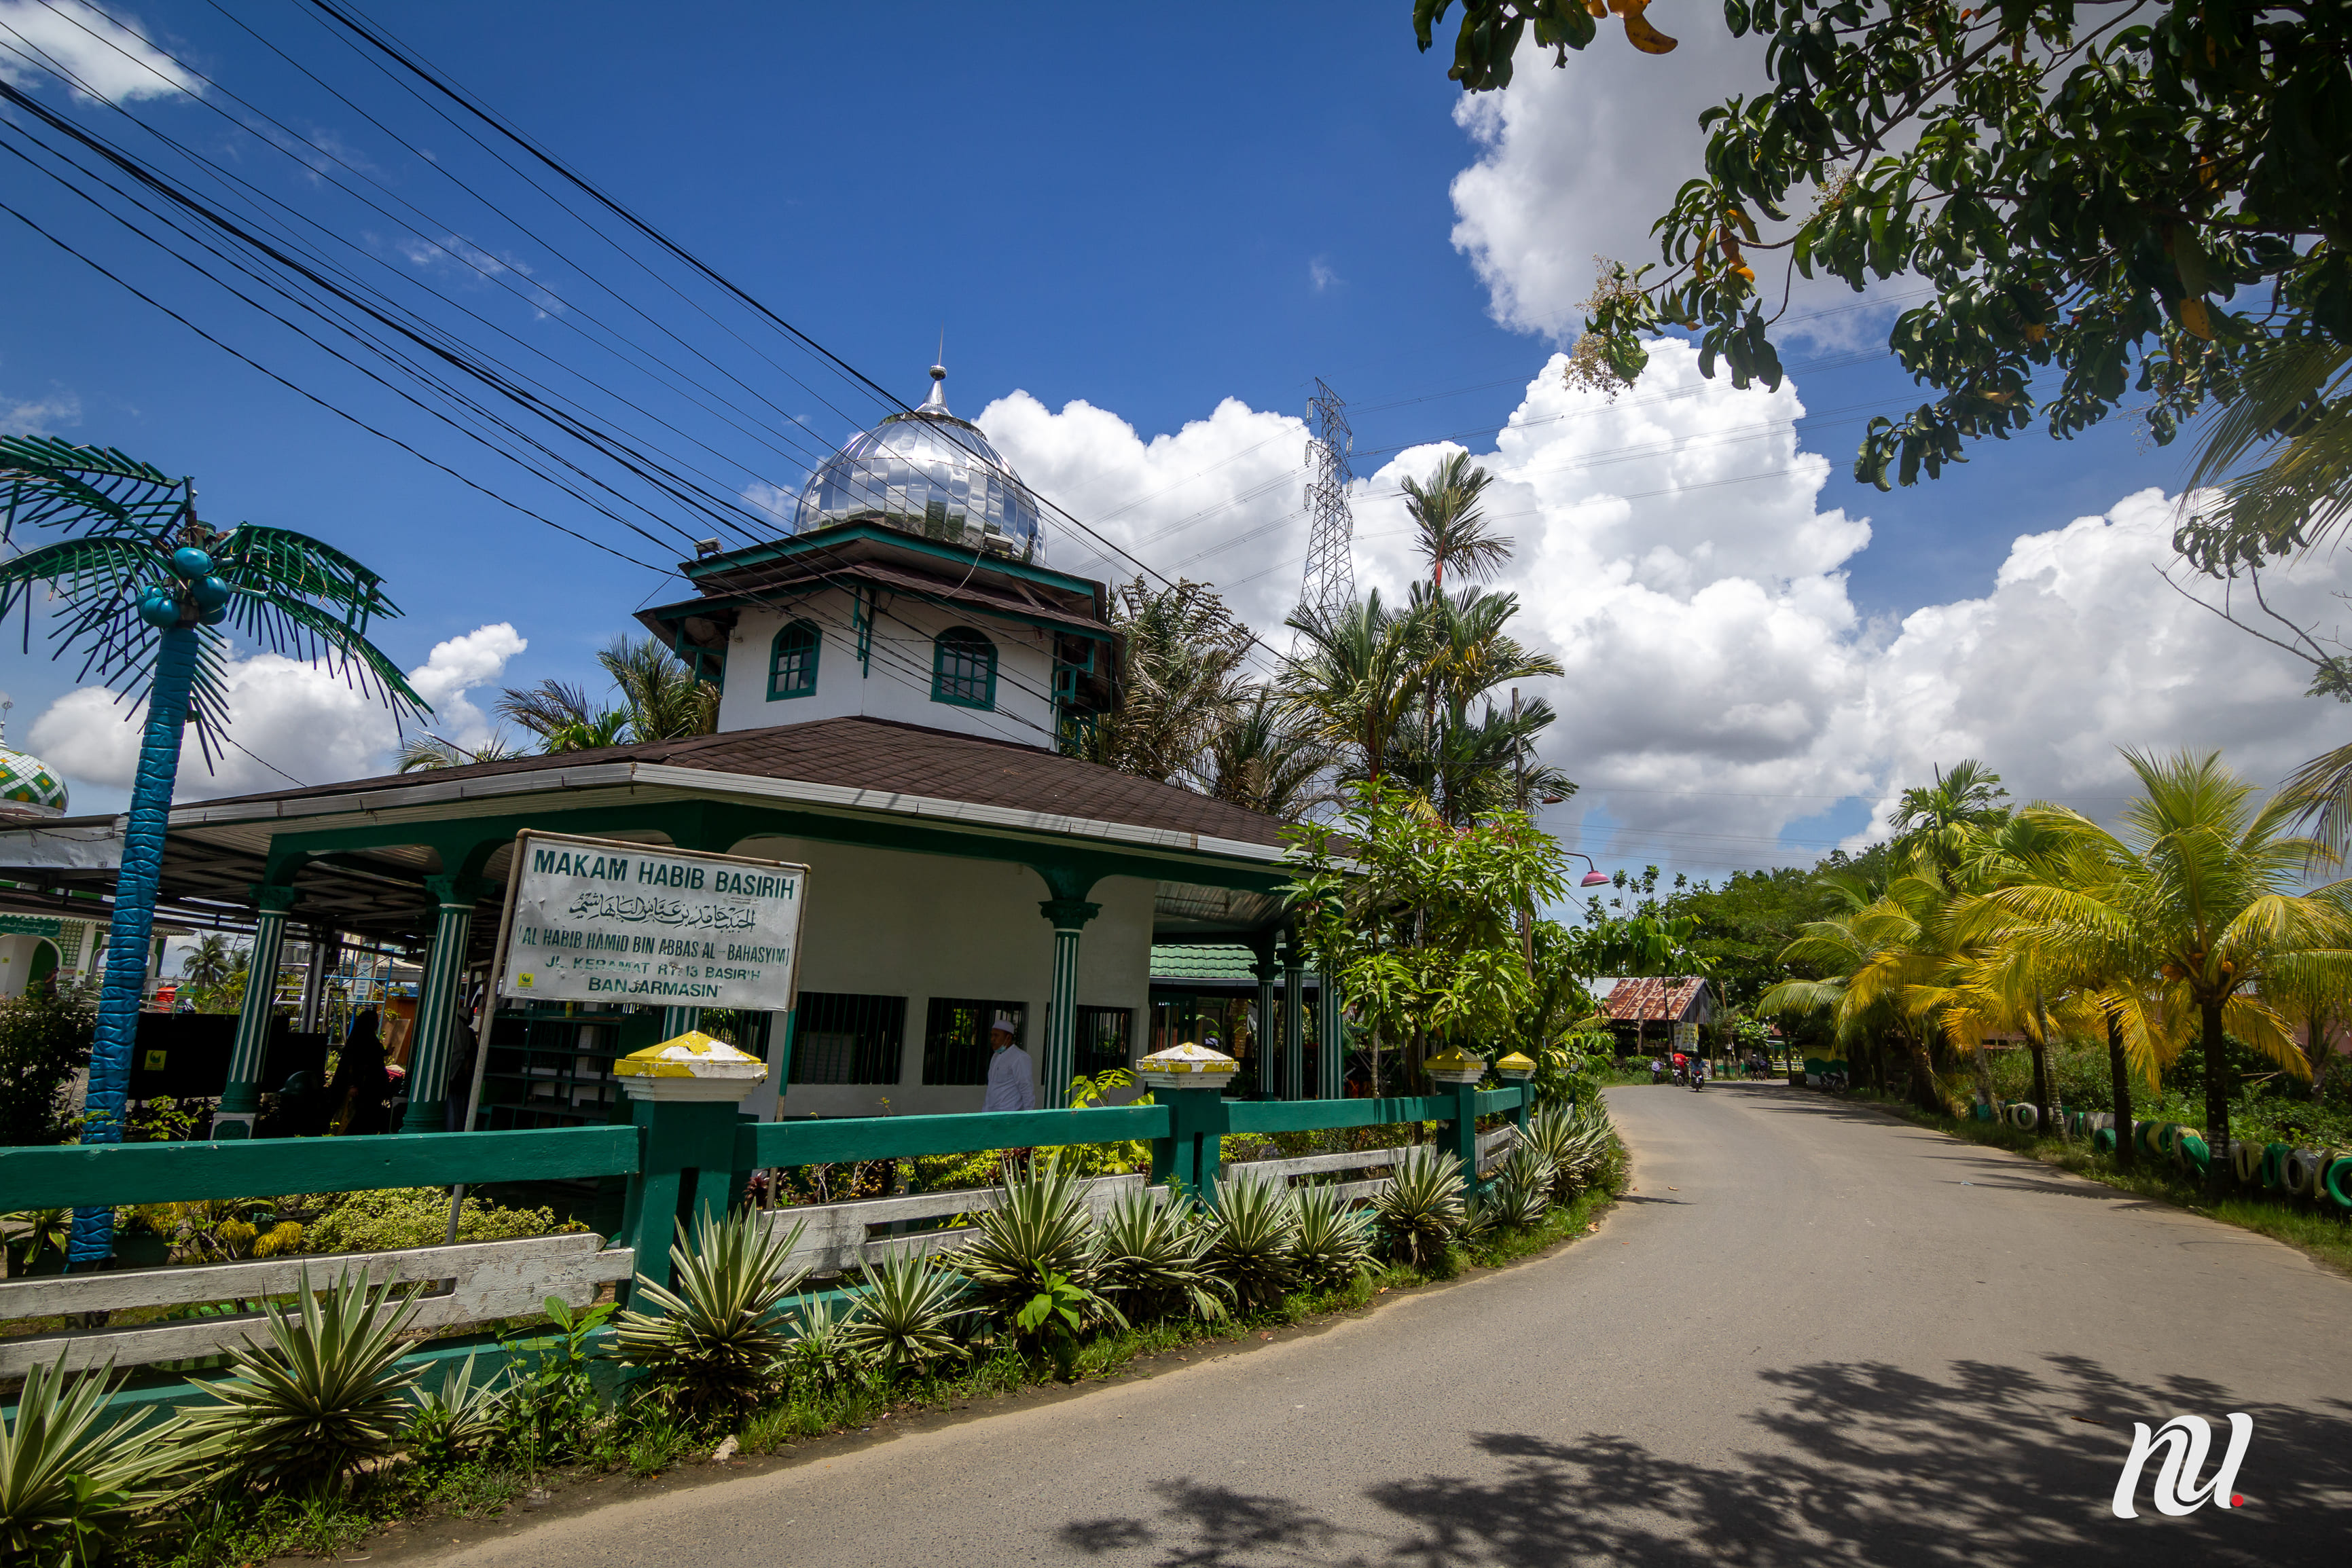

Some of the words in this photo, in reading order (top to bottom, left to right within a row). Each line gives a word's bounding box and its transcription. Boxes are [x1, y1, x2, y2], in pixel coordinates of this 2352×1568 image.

[533, 849, 629, 881] MAKAM
[638, 861, 705, 890] HABIB
[714, 871, 795, 900] BASIRIH
[543, 928, 583, 949] HABIB
[586, 932, 630, 952] HAMID
[632, 936, 655, 954] BIN
[658, 938, 699, 958] ABBAS
[573, 958, 650, 974] KERAMAT
[686, 965, 698, 977] 13
[705, 966, 761, 981] BASIRIH
[588, 977, 719, 998] BANJARMASIN
